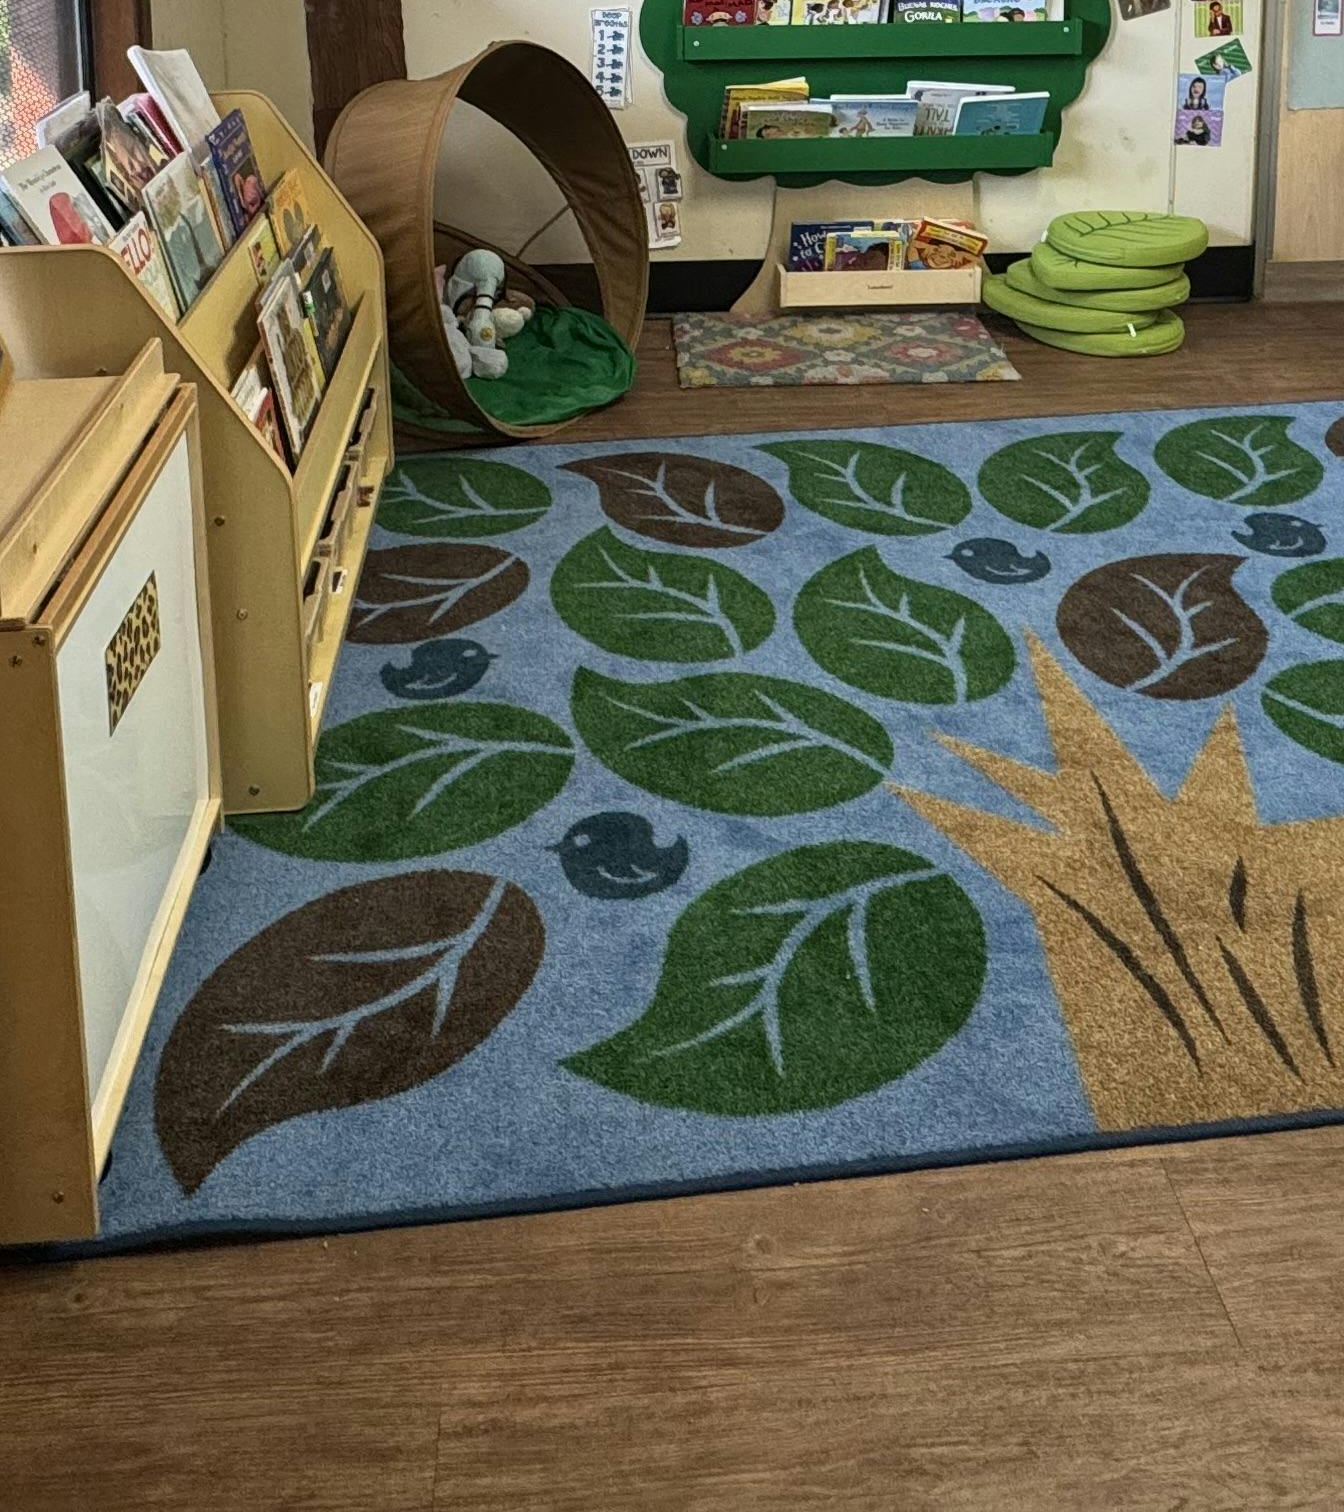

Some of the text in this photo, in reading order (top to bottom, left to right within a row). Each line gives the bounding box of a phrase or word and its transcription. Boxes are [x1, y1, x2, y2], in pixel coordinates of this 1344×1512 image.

[598, 30, 605, 41] 1
[597, 43, 606, 55] 2
[597, 57, 606, 69] 3
[595, 71, 606, 83] 4
[632, 147, 669, 160] DOWN
